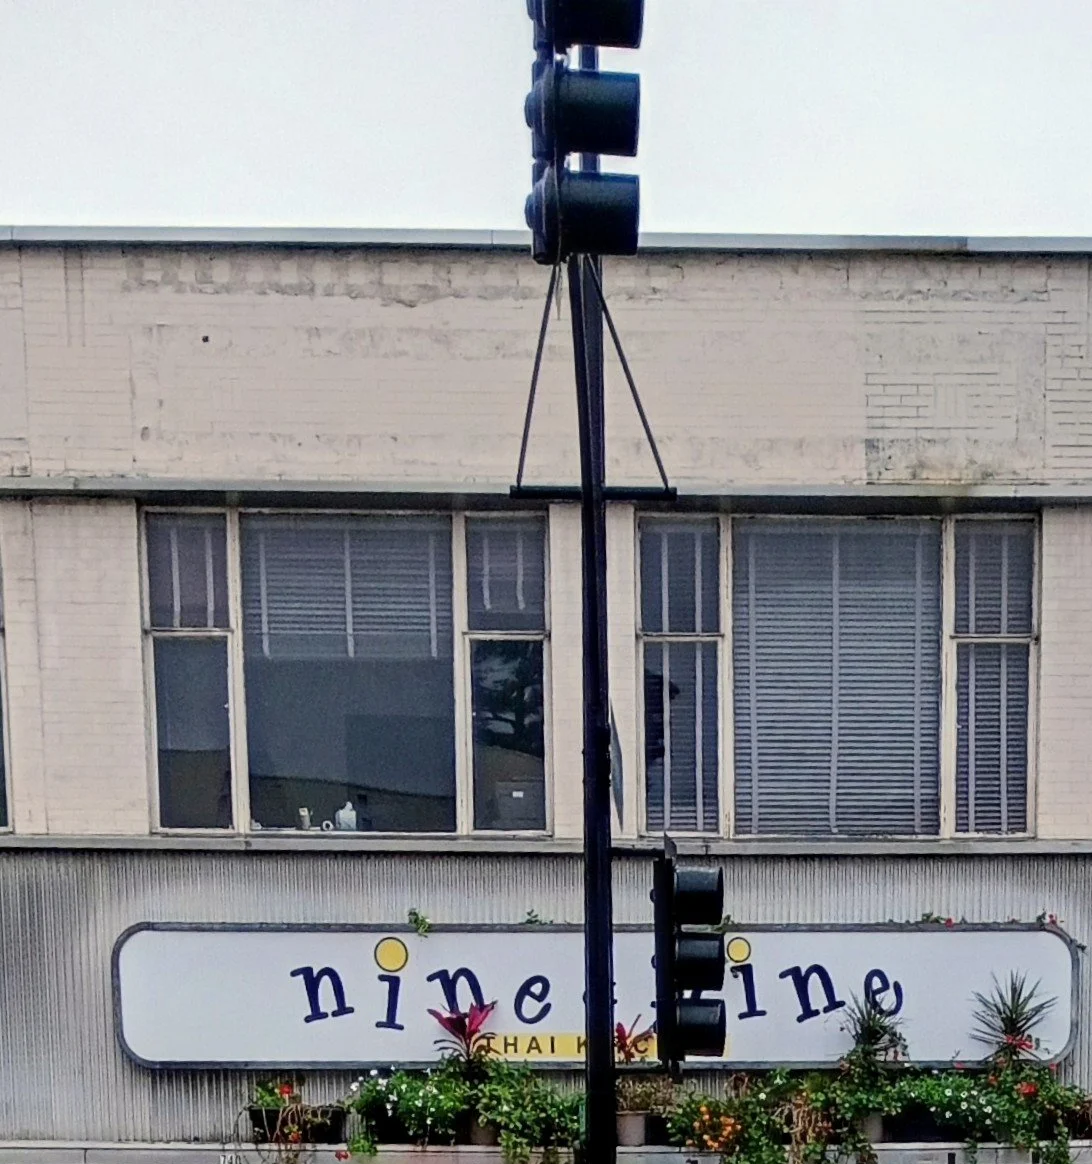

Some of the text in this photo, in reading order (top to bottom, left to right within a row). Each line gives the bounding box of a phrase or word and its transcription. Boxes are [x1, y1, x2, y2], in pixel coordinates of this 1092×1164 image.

[290, 936, 903, 1031] nine ine
[485, 1034, 556, 1055] THAI
